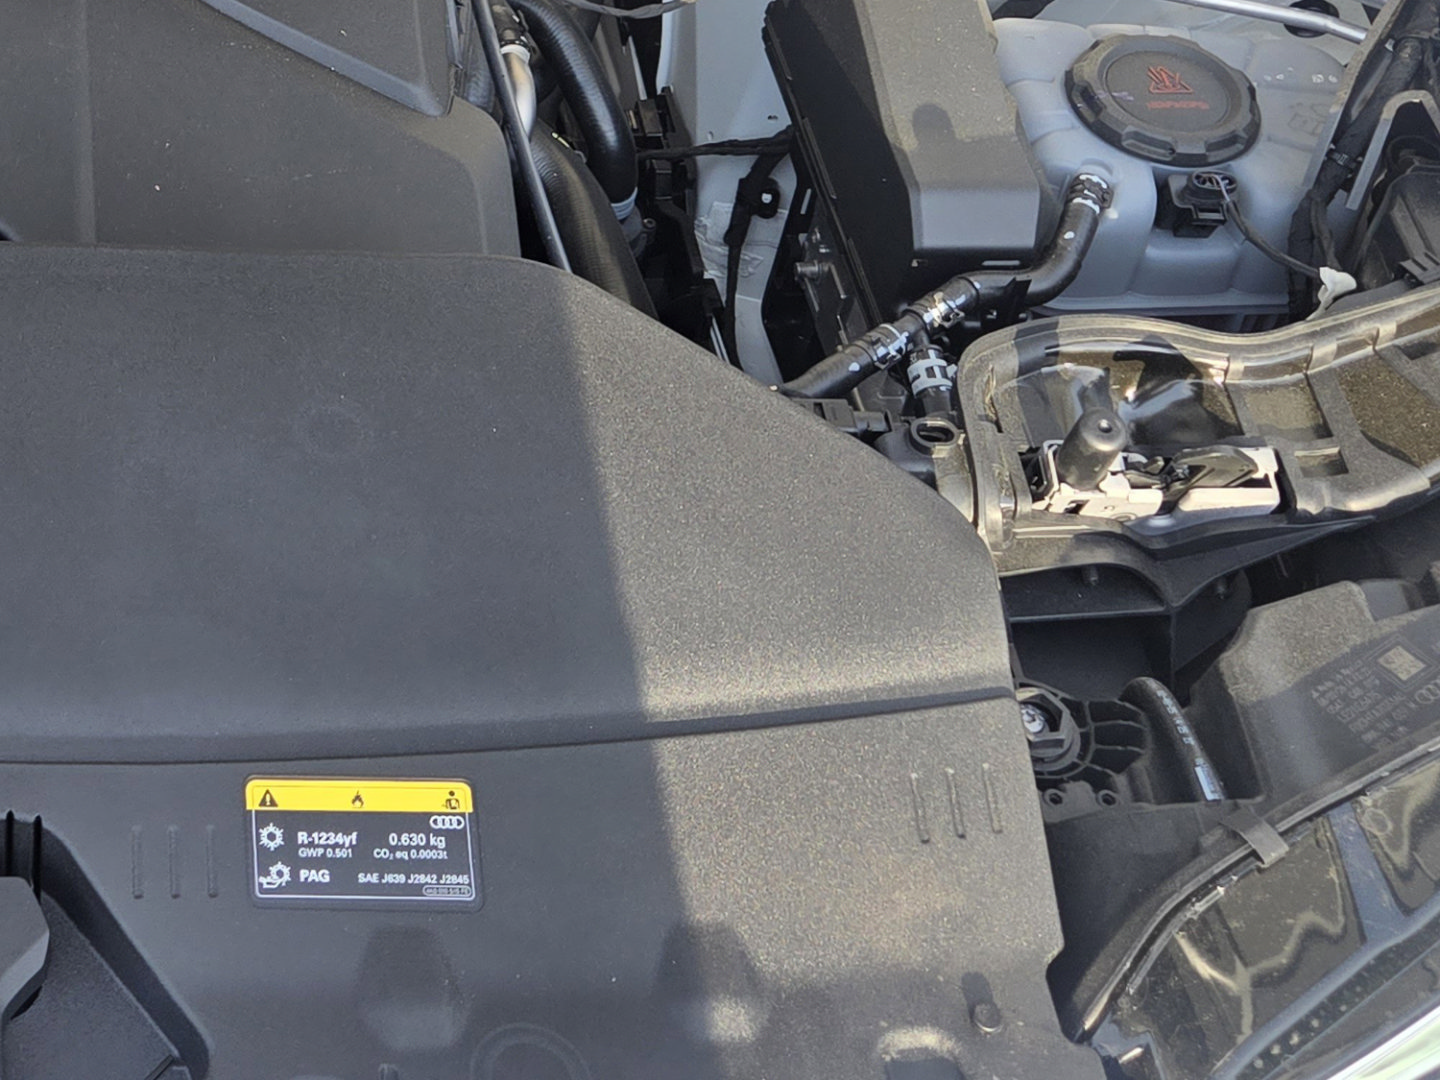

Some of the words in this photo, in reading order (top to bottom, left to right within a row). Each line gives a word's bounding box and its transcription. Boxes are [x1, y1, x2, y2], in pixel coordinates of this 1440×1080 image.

[297, 831, 358, 847] R-1234yf
[388, 833, 426, 846] 0.630
[429, 833, 446, 849] kg
[298, 848, 325, 858] GWP
[325, 848, 353, 858] 0.501
[395, 850, 409, 860] eq
[410, 849, 448, 860] 0.0003t
[299, 869, 331, 883] PAG
[358, 873, 380, 884] SAE
[382, 873, 406, 884] J639
[408, 873, 437, 884] J2842
[439, 874, 469, 885] J2845
